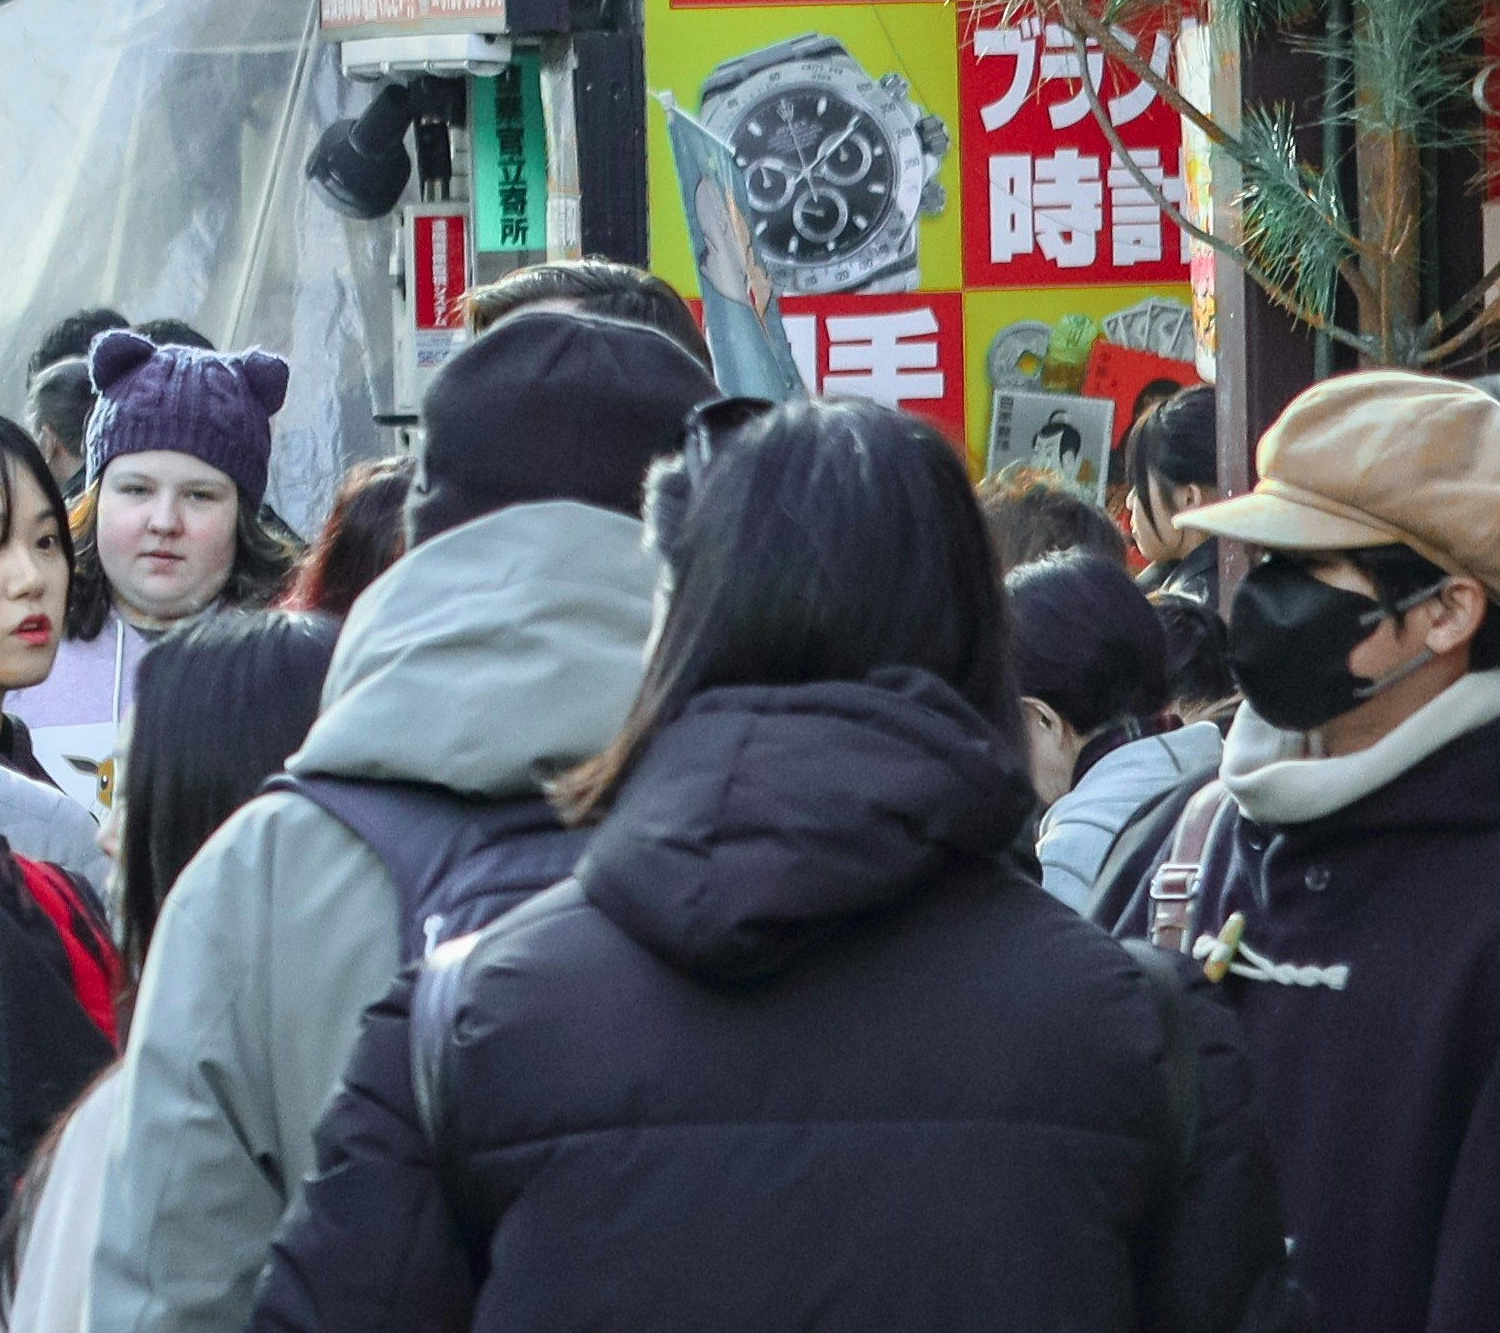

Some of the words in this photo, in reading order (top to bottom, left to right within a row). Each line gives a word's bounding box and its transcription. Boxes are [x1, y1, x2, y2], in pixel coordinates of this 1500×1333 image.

[972, 21, 1190, 135] ブラン
[987, 148, 1192, 271] 時計
